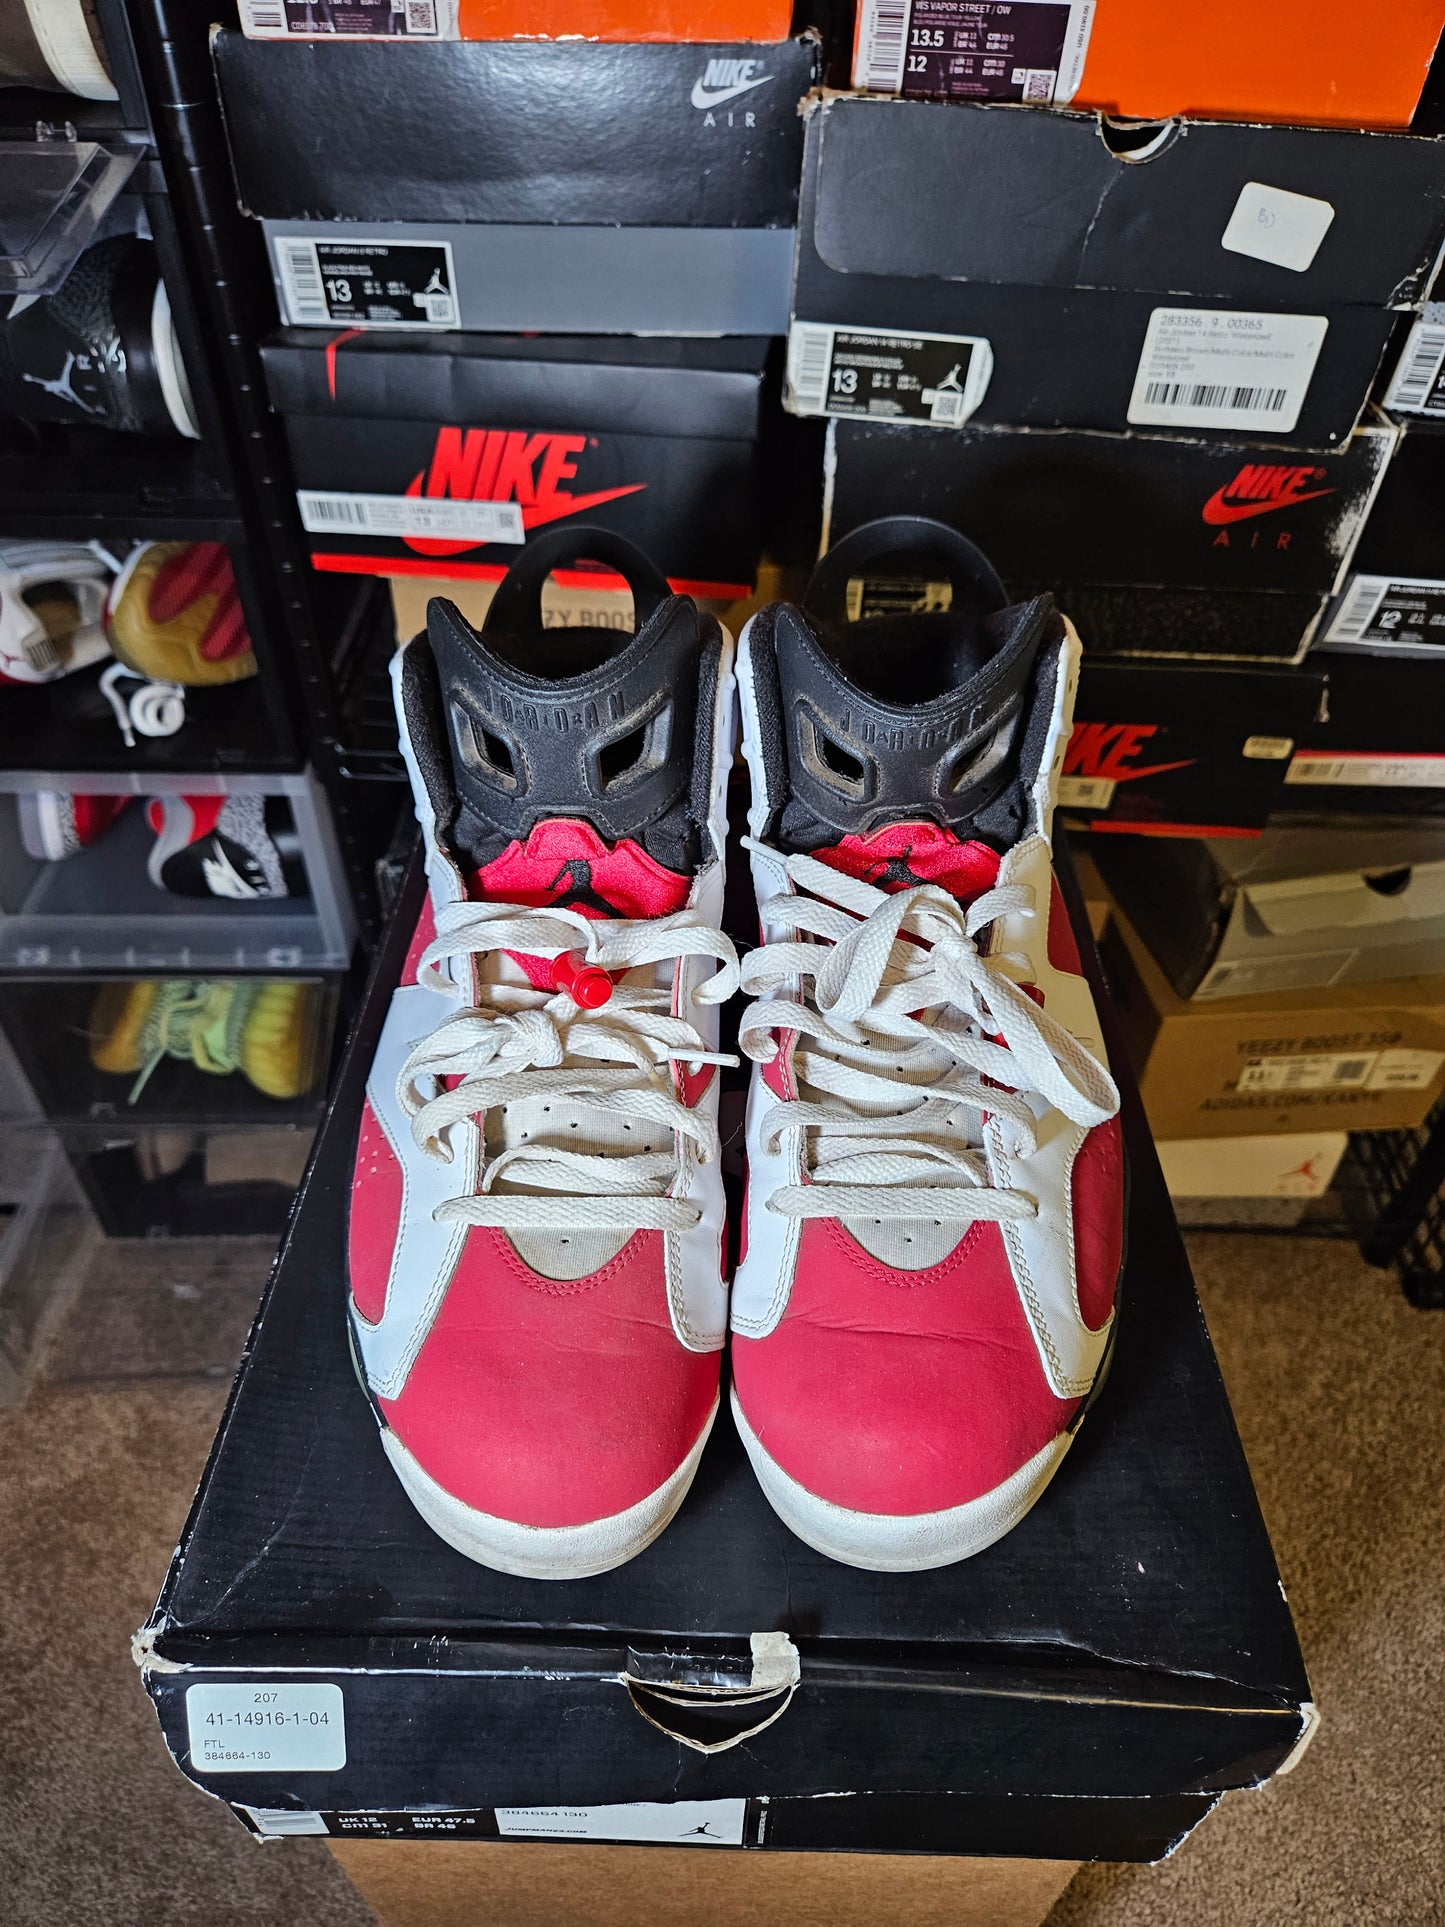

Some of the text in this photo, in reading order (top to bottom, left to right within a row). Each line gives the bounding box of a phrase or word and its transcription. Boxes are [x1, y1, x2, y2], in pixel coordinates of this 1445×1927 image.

[931, 2, 958, 12] VAPOR
[959, 3, 991, 14] STREET
[910, 29, 945, 47] 13.5
[703, 59, 758, 88] NIKE
[907, 55, 928, 73] 12
[703, 111, 756, 128] AIR
[325, 279, 353, 303] 13
[831, 367, 858, 394] 13
[425, 427, 587, 507] NIKE
[1223, 465, 1315, 501] NIKE
[1212, 529, 1292, 550] AIR
[1379, 610, 1402, 629] 12
[484, 684, 626, 734] JORDAN
[1060, 722, 1159, 779] IKE
[254, 1692, 278, 1703] 207
[206, 1711, 329, 1726] 41-14916-1-04
[204, 1739, 226, 1749] FTL
[204, 1751, 271, 1760] 384664-130
